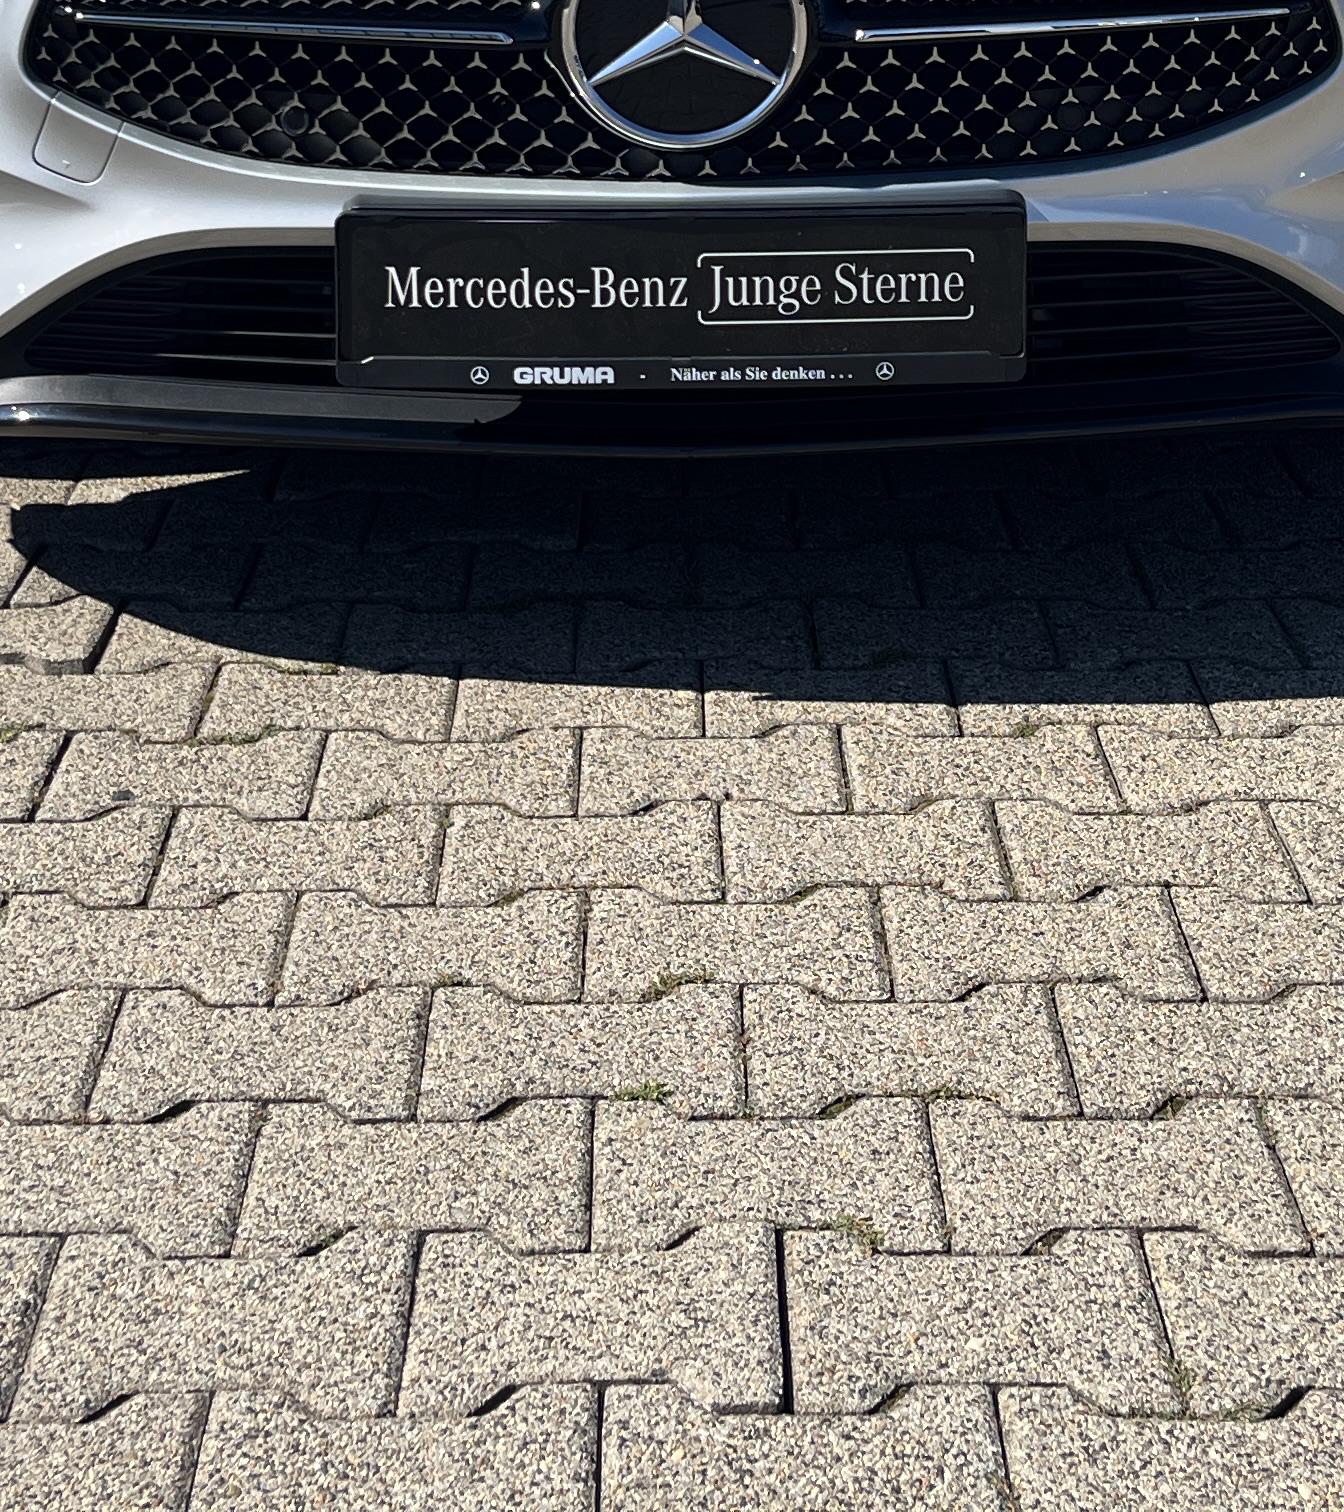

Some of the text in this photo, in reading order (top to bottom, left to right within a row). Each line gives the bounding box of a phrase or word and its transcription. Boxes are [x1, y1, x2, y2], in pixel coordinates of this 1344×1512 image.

[384, 262, 965, 316] Mercedes-Benz Junge Sterne
[513, 366, 615, 385] GRUMA
[670, 367, 717, 382] Näher
[720, 367, 742, 381] als
[745, 367, 768, 381] Sie
[771, 366, 826, 381] denken
